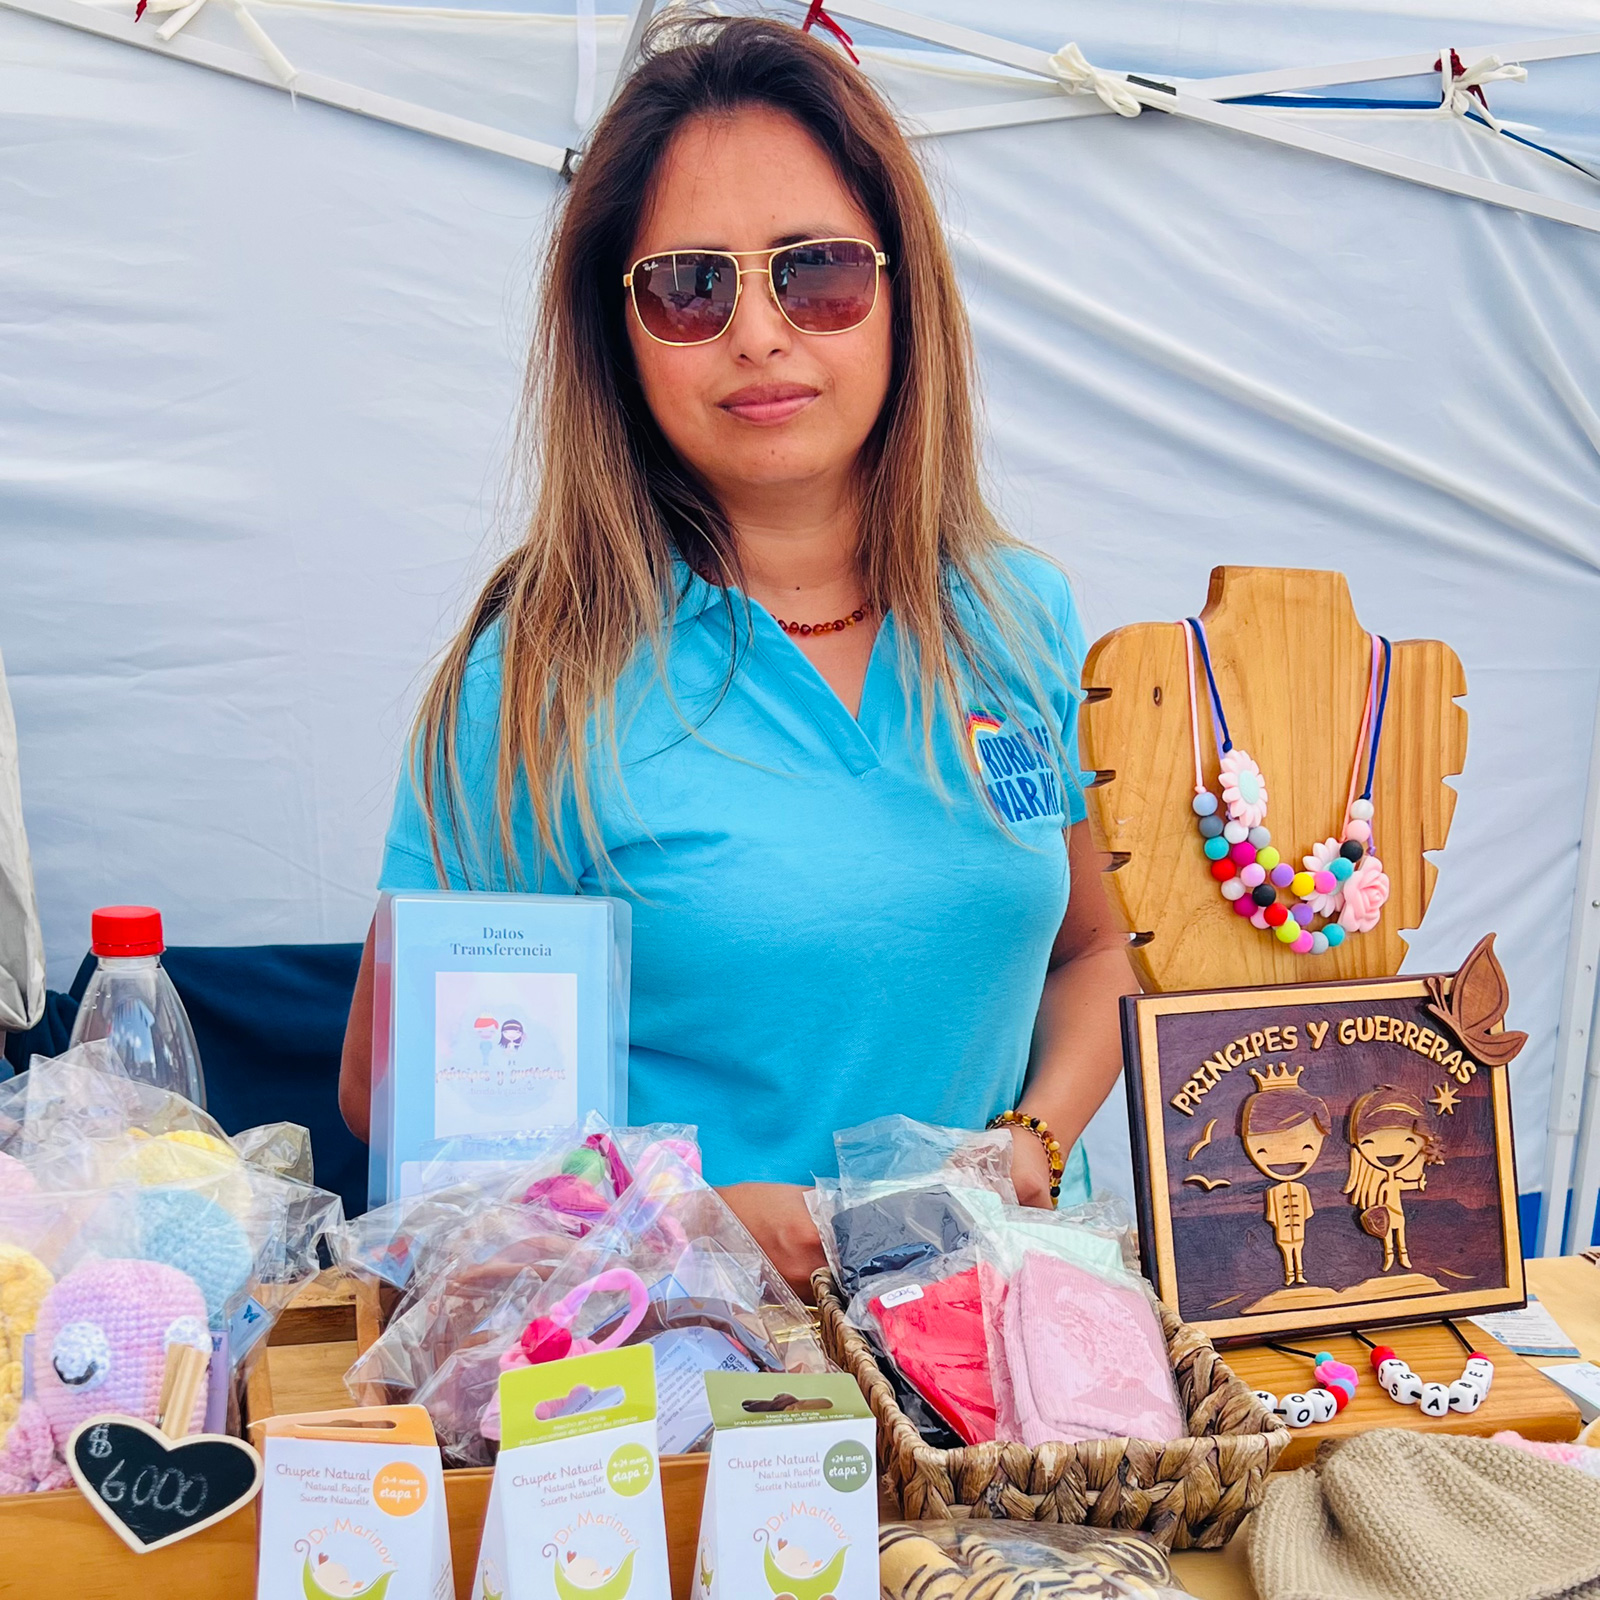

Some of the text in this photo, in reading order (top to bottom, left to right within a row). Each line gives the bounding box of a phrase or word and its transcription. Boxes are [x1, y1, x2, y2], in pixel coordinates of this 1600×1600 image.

[483, 926, 524, 940] Datos
[449, 942, 552, 957] Transferencia
[1170, 1015, 1477, 1116] PRINCIPES Y GUERRERAS
[727, 1452, 821, 1472] Chupete Natural
[829, 1461, 868, 1480] etapa 3
[276, 1463, 371, 1480] Chupete Natural
[512, 1458, 604, 1487] Chupete Natural
[613, 1463, 650, 1484] etapa 2
[758, 1470, 791, 1480] Natural
[100, 1458, 208, 1516] 6000
[305, 1481, 339, 1492] Natural
[544, 1480, 576, 1494] Natural
[784, 1479, 821, 1490] Naturelle
[330, 1495, 370, 1506] Naturelle
[380, 1487, 421, 1504] etapa 1
[570, 1486, 607, 1501] Naturelle
[554, 1509, 634, 1545] Dr. Marinov
[766, 1500, 847, 1540] Dr. Marinov
[308, 1517, 393, 1564] Dr. Marinov
